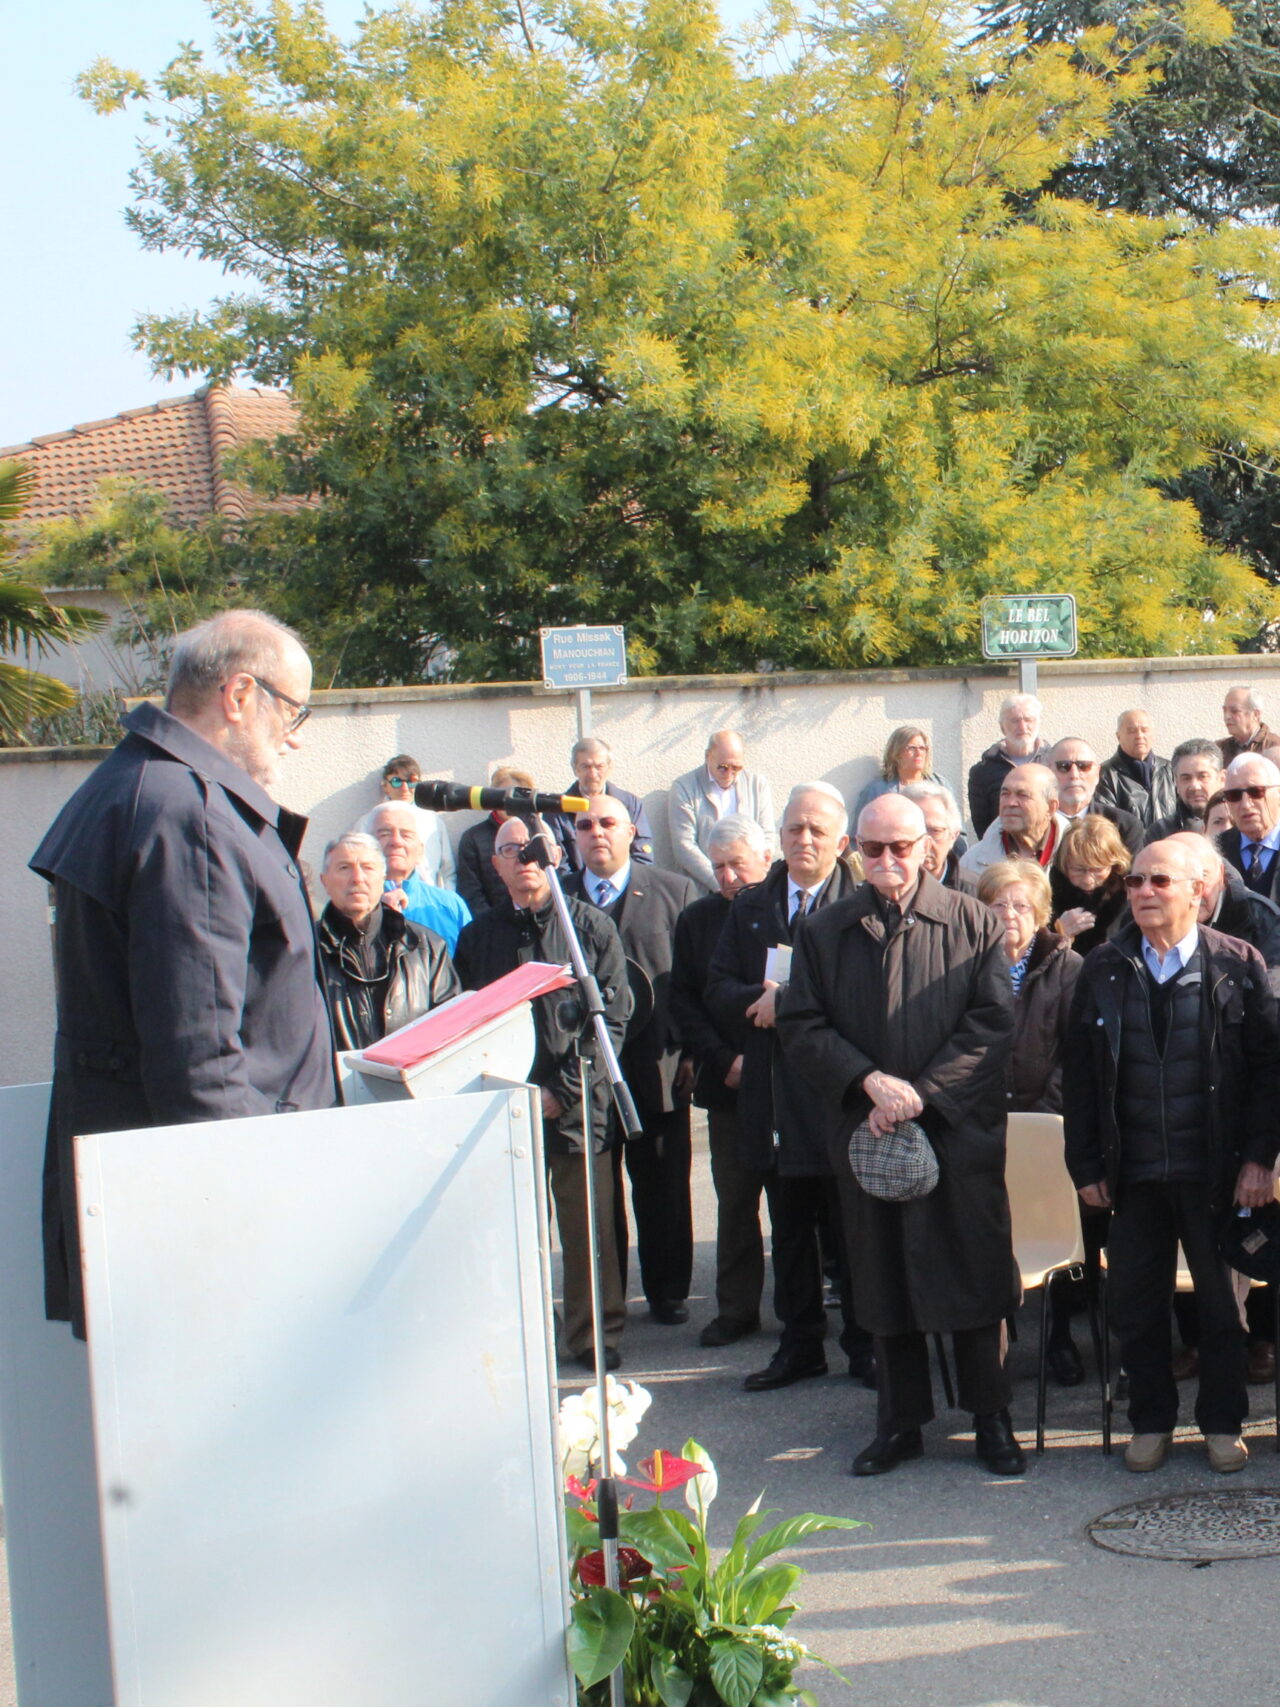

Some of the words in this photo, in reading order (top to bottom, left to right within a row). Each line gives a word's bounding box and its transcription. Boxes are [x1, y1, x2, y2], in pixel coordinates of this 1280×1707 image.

[1008, 608, 1023, 622] LE
[1027, 608, 1050, 622] BEL
[553, 634, 573, 643] Rue
[577, 632, 611, 642] Missak
[1000, 629, 1059, 644] HORIZON
[564, 672, 606, 681] 1906-1944
